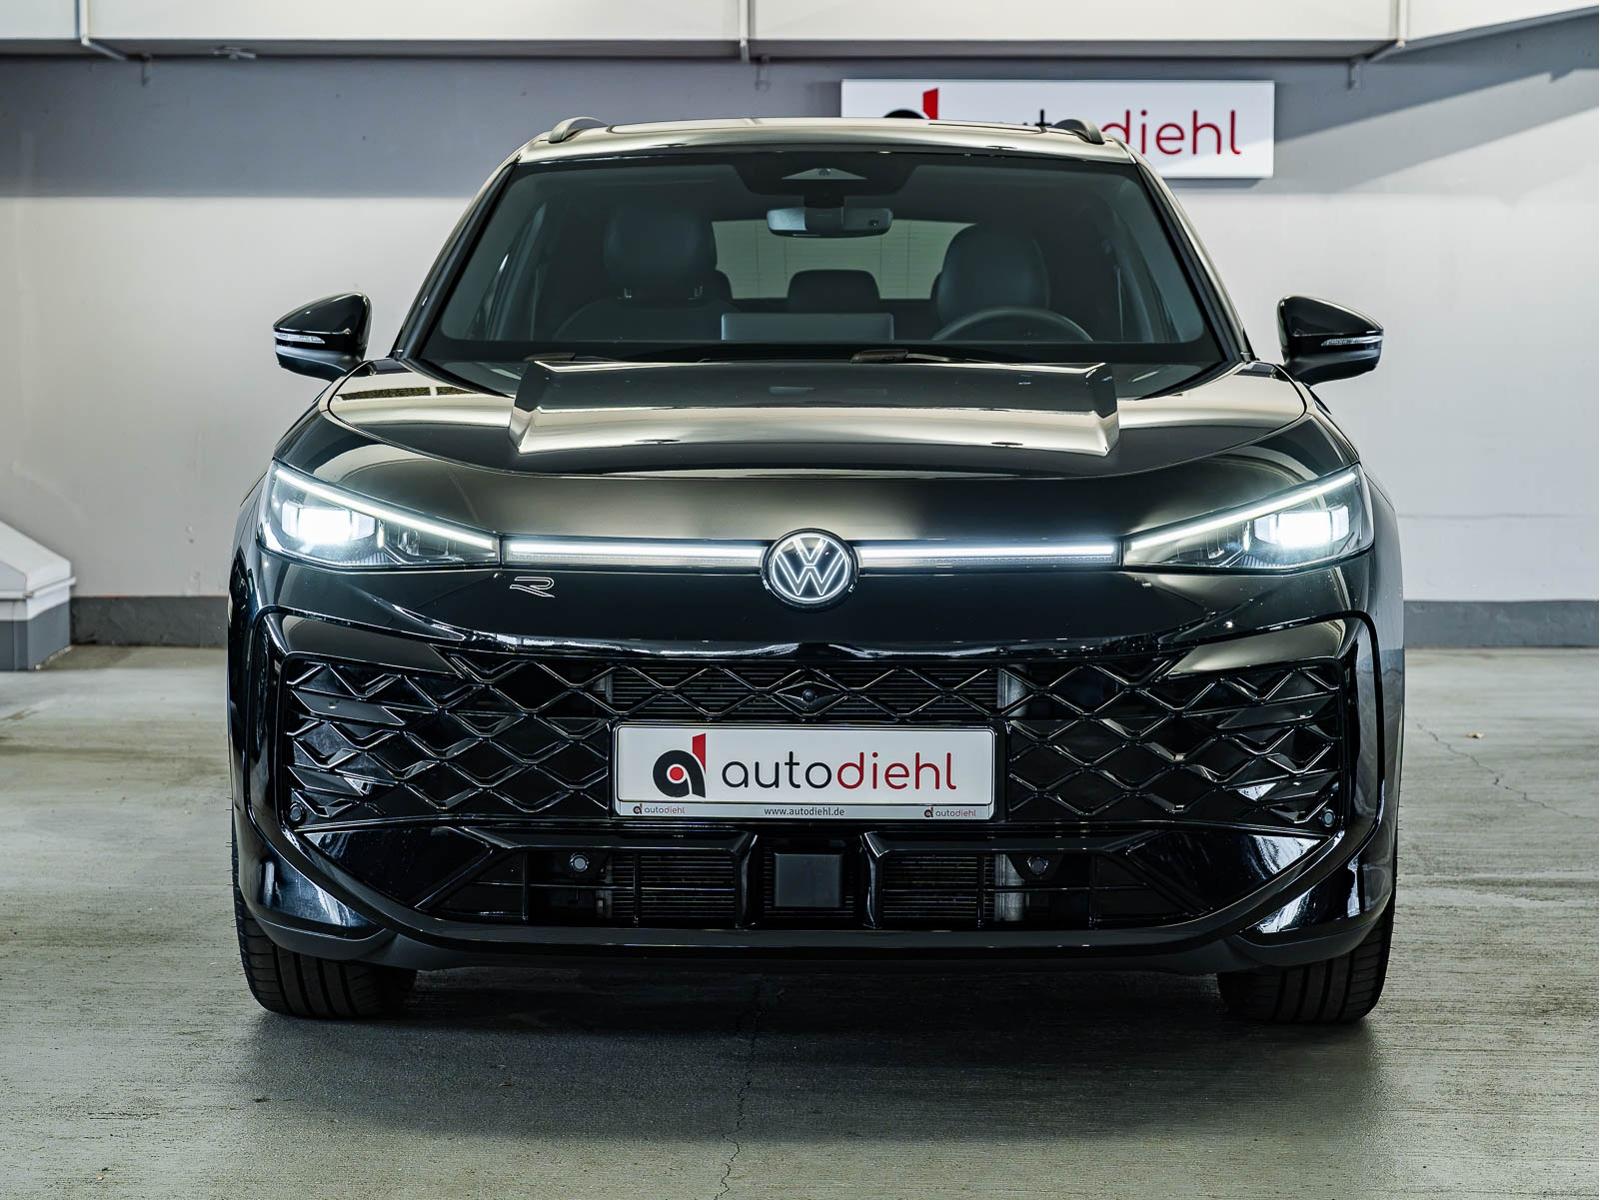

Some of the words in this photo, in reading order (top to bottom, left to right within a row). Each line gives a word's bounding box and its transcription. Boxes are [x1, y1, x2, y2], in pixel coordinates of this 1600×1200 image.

[1023, 109, 1242, 155] diehl
[721, 750, 957, 790] autodiehl
[644, 805, 686, 815] autodiehl
[763, 806, 845, 817] www.autodiehl.de
[935, 808, 977, 818] autodiehl
